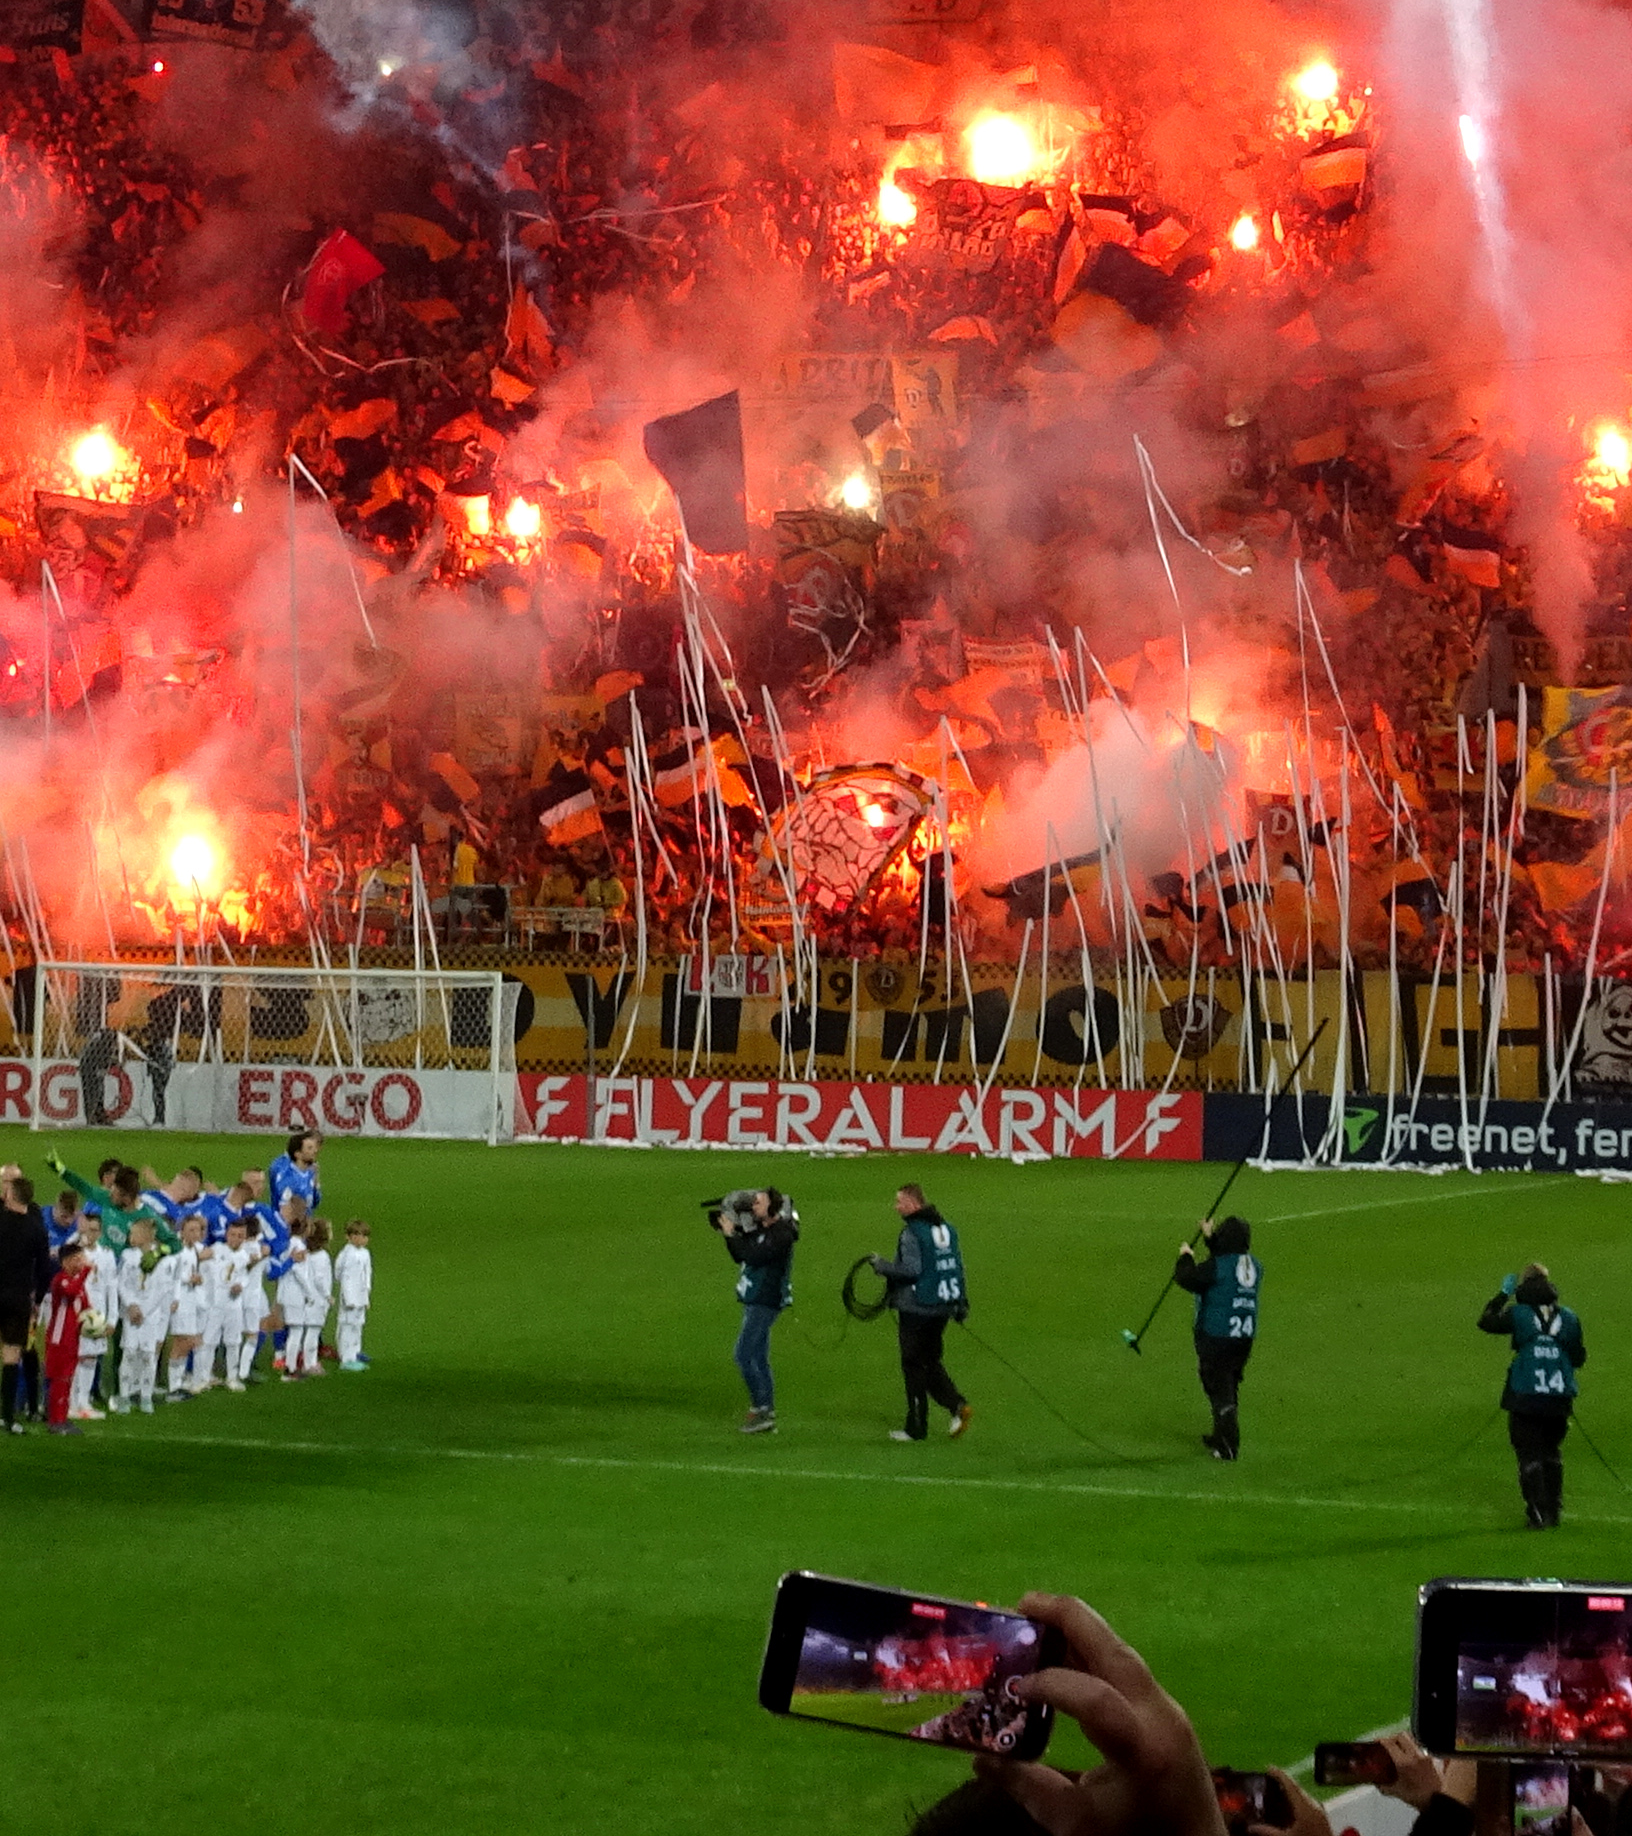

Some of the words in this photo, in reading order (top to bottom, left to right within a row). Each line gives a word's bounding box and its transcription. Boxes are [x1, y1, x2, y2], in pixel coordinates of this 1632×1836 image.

[238, 1070, 423, 1131] ERGO
[594, 1076, 1117, 1157] FLYERALARM
[1390, 1112, 1567, 1167] freenet,
[1229, 1315, 1254, 1338] 24
[1534, 1368, 1566, 1394] 14
